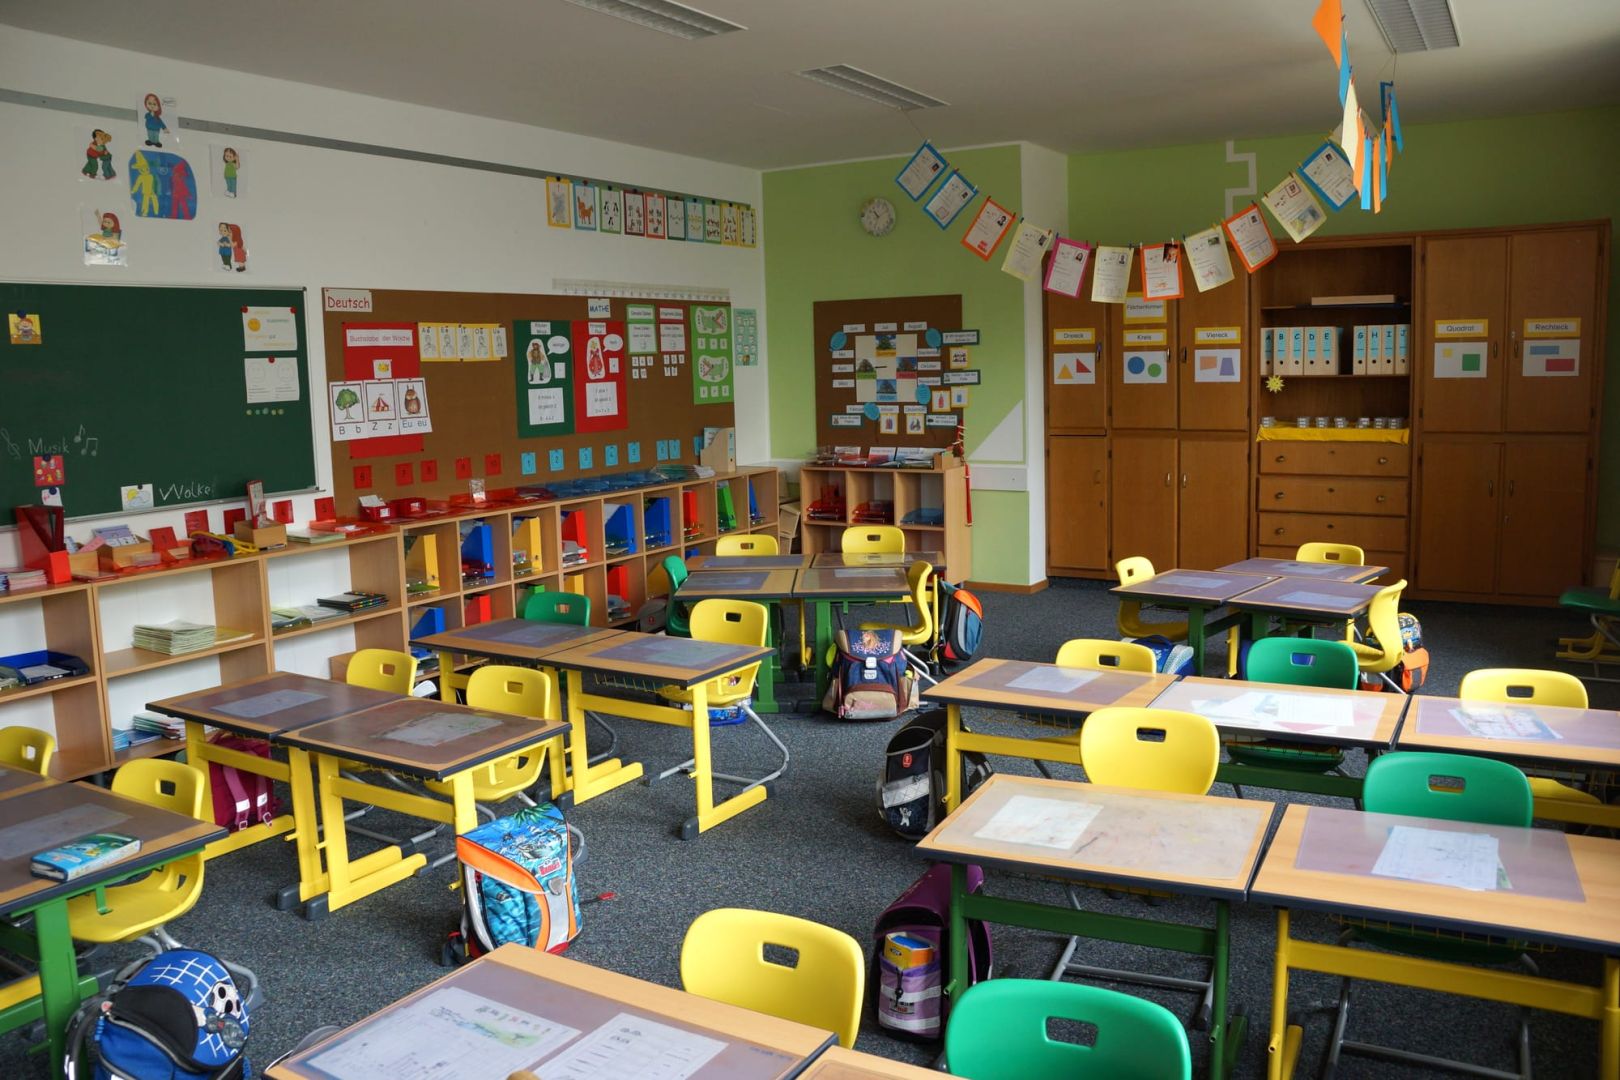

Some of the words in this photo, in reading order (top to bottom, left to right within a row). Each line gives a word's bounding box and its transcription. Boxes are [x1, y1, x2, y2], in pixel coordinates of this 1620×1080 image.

[327, 296, 370, 309] Deutsch
[590, 304, 610, 313] MATHE
[1446, 324, 1475, 332] Quadrat
[1535, 322, 1569, 331] Rechteck
[372, 422, 378, 431] Z
[402, 420, 413, 428] Eu
[417, 420, 427, 428] eu
[339, 426, 346, 435] B
[356, 425, 362, 433] b
[28, 437, 70, 456] Musik
[158, 482, 212, 502] Wolke
